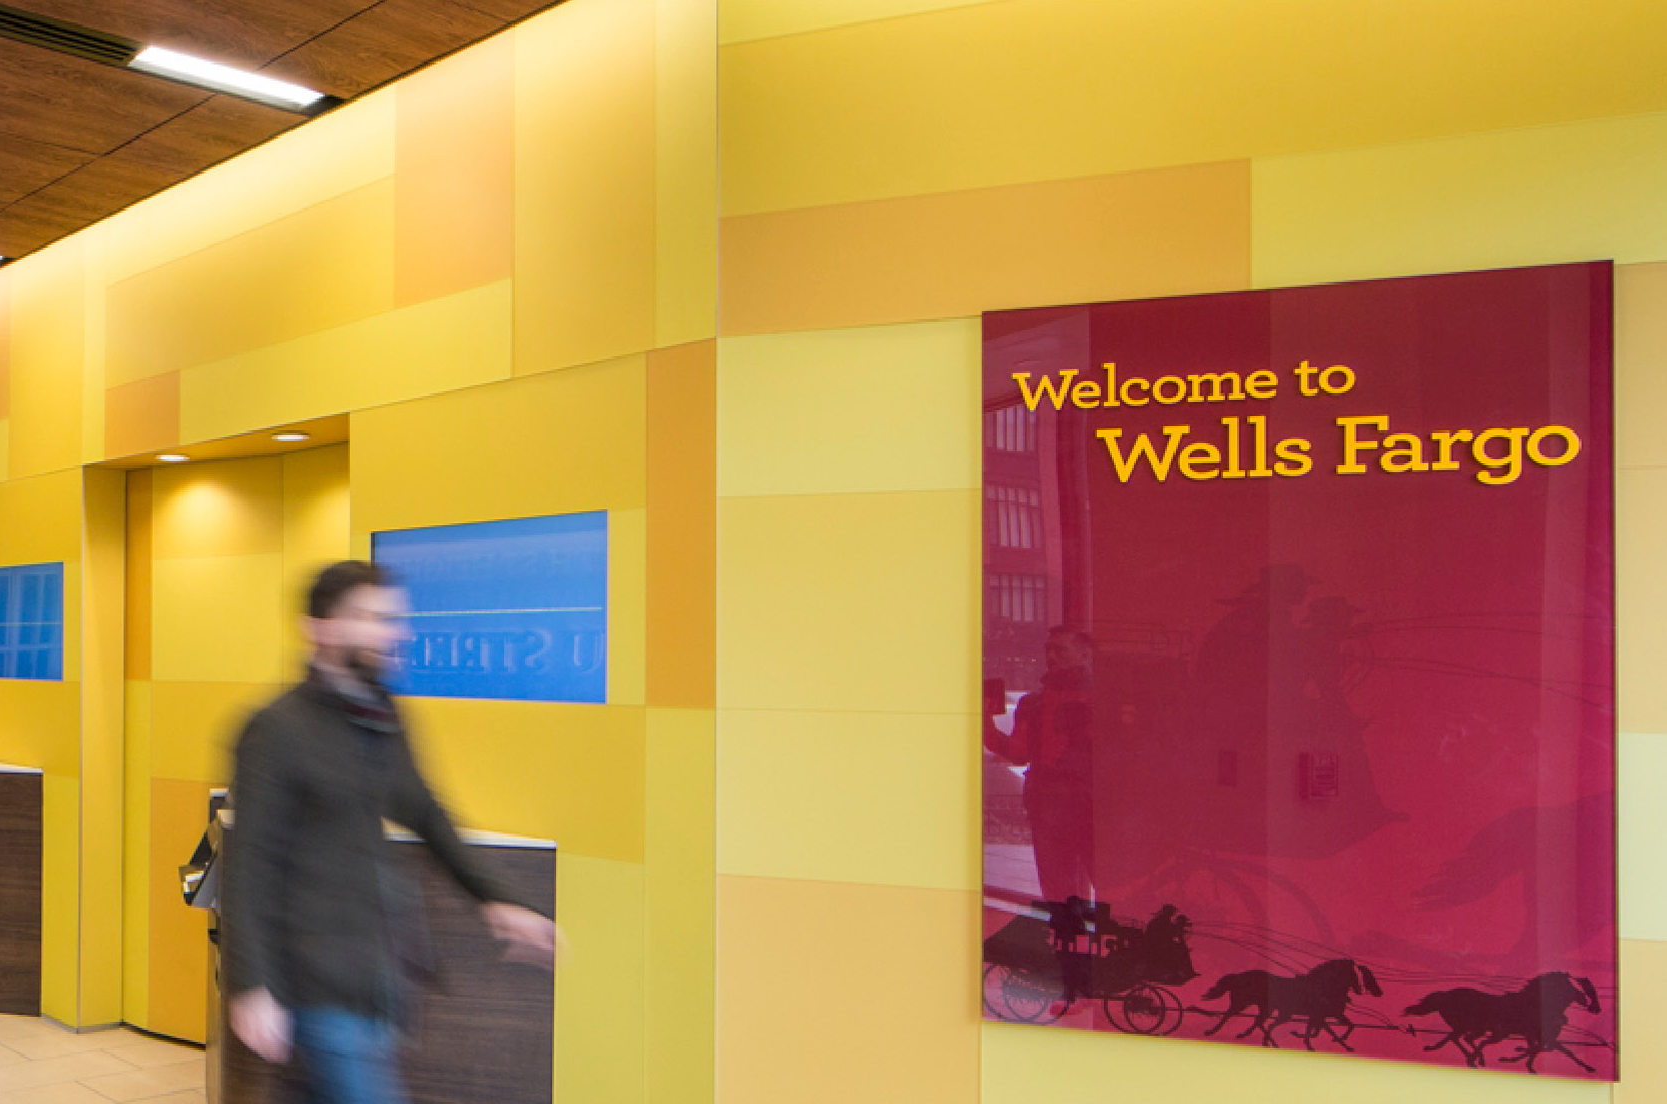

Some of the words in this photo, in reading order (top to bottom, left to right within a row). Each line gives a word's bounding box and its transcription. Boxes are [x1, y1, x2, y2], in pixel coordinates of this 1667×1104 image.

[1013, 363, 1277, 411] Welcome
[1294, 360, 1355, 397] to
[1097, 415, 1312, 483] Wells
[1336, 415, 1581, 485] Fargo
